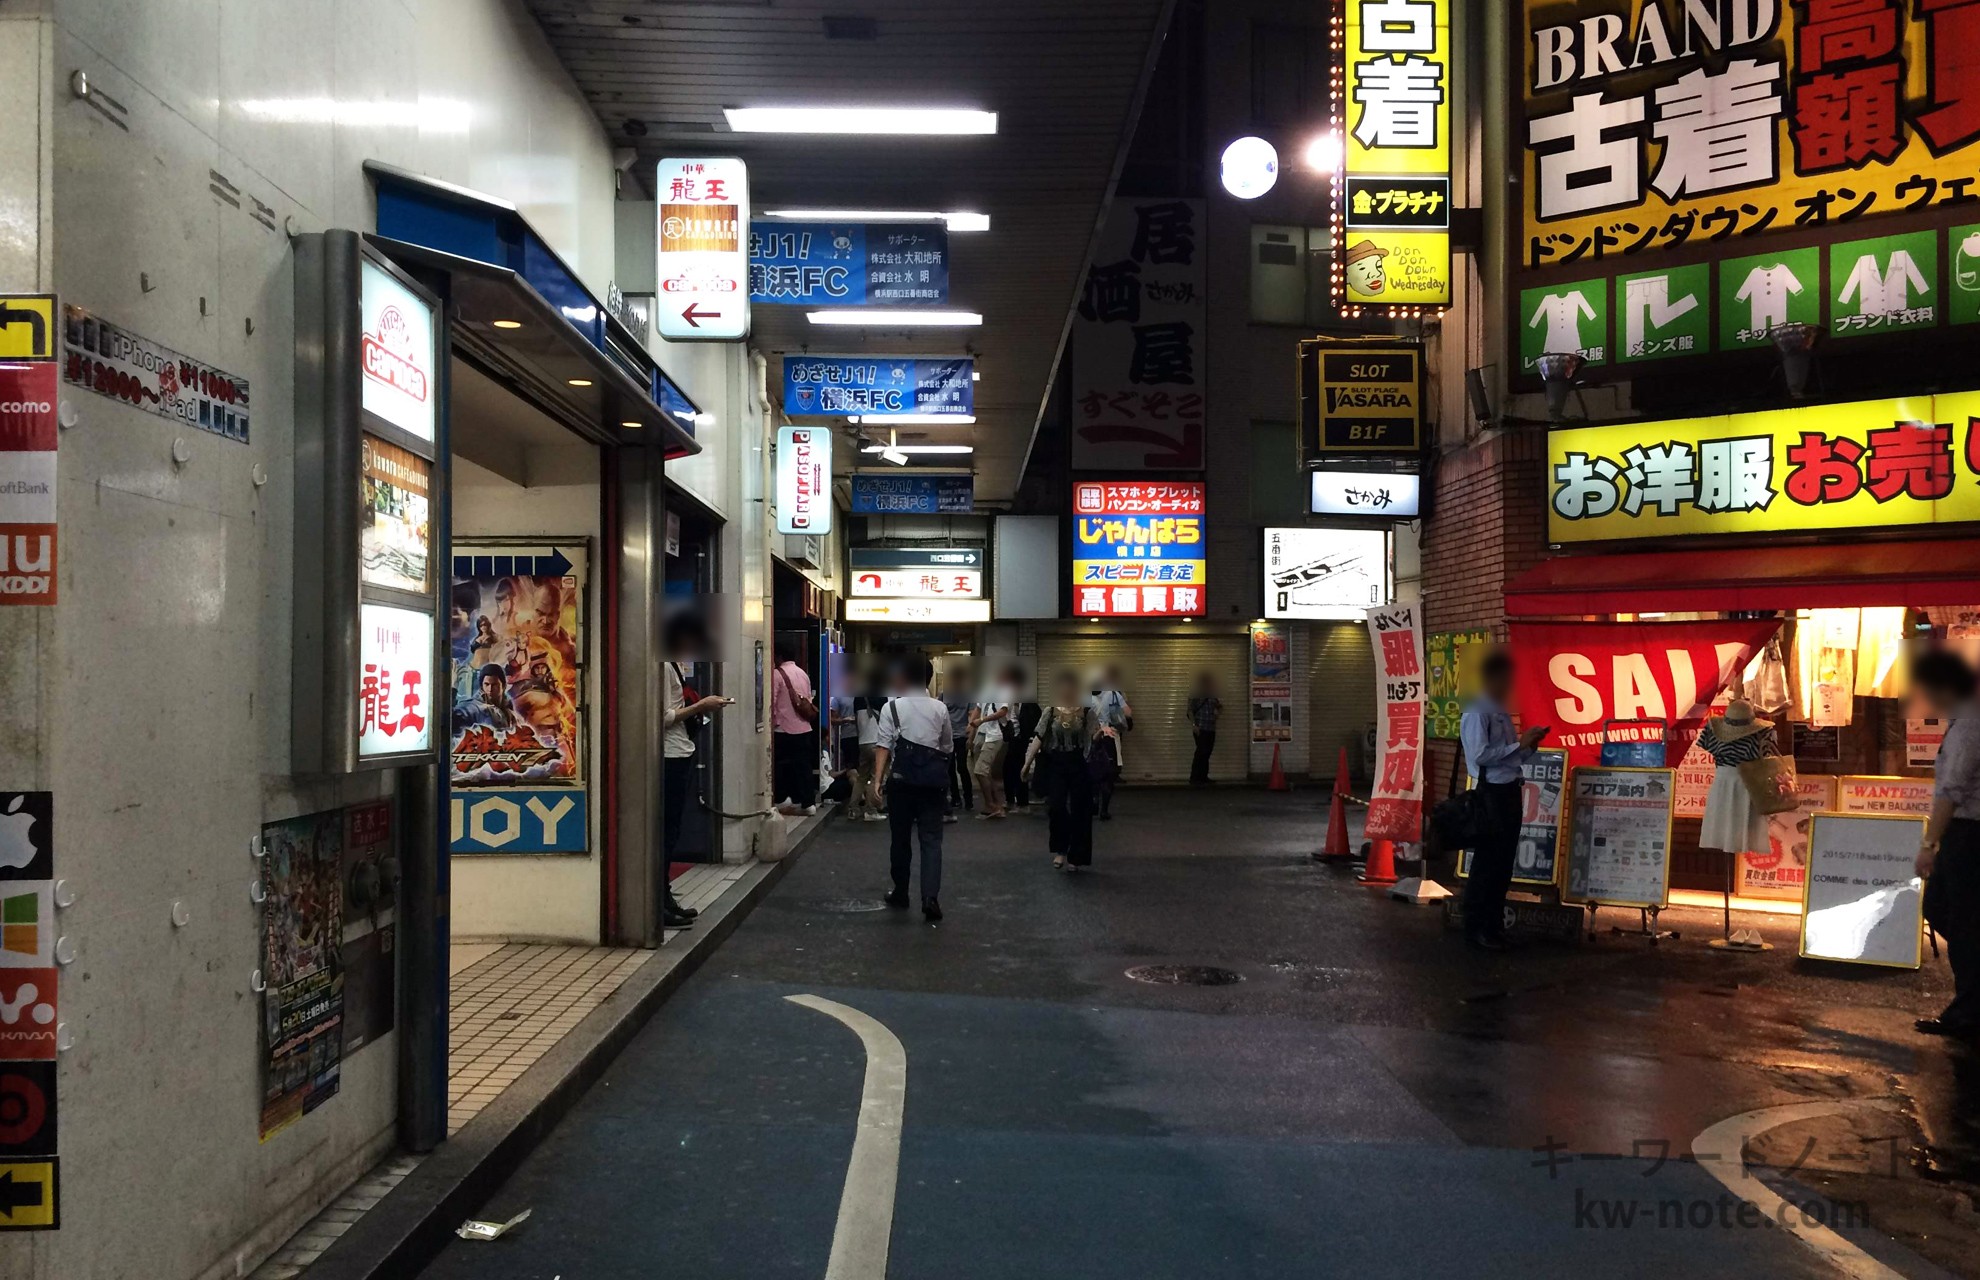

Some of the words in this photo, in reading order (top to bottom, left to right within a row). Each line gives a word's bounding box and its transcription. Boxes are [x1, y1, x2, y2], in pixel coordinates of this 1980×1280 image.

[1529, 59, 1782, 218] 古着
[682, 163, 705, 175] 中華
[669, 178, 729, 201] 龍王
[1352, 189, 1444, 215] 金・プラチナ
[1530, 207, 1778, 270] ドンドンダウン
[1794, 188, 1878, 227] オン
[1894, 172, 1980, 201] ウェ
[887, 233, 926, 244] サポーター
[871, 252, 902, 265] 株式会社
[904, 251, 942, 265] 大和地所
[1390, 277, 1446, 294] Wednesday
[1834, 306, 1935, 331] ブランド衣料
[1631, 337, 1694, 357] メンズ服
[791, 363, 877, 385] めざせJ1!
[1349, 364, 1390, 378] SLOT
[0, 402, 51, 413] como
[820, 388, 903, 411] 横浜FC
[1325, 386, 1412, 414] VASARA
[1349, 425, 1387, 440] B1F
[1554, 440, 1777, 518] お洋服
[1107, 486, 1201, 499] スマホ・タブレット
[1107, 499, 1201, 511] パソコン・オーディオ
[1084, 563, 1194, 581] スピード査定
[920, 575, 973, 594] 龍王
[1080, 586, 1198, 613] 高価買取
[359, 664, 425, 737] 龍王
[1559, 735, 1577, 746] TO
[1578, 732, 1604, 746] YOU
[1607, 728, 1640, 742] WHO
[451, 752, 526, 763] TEKKEN
[1580, 783, 1645, 797] フロア案内
[1867, 801, 1886, 809] NEW
[1888, 802, 1930, 812] BALANCE
[1813, 873, 1849, 885] COMME
